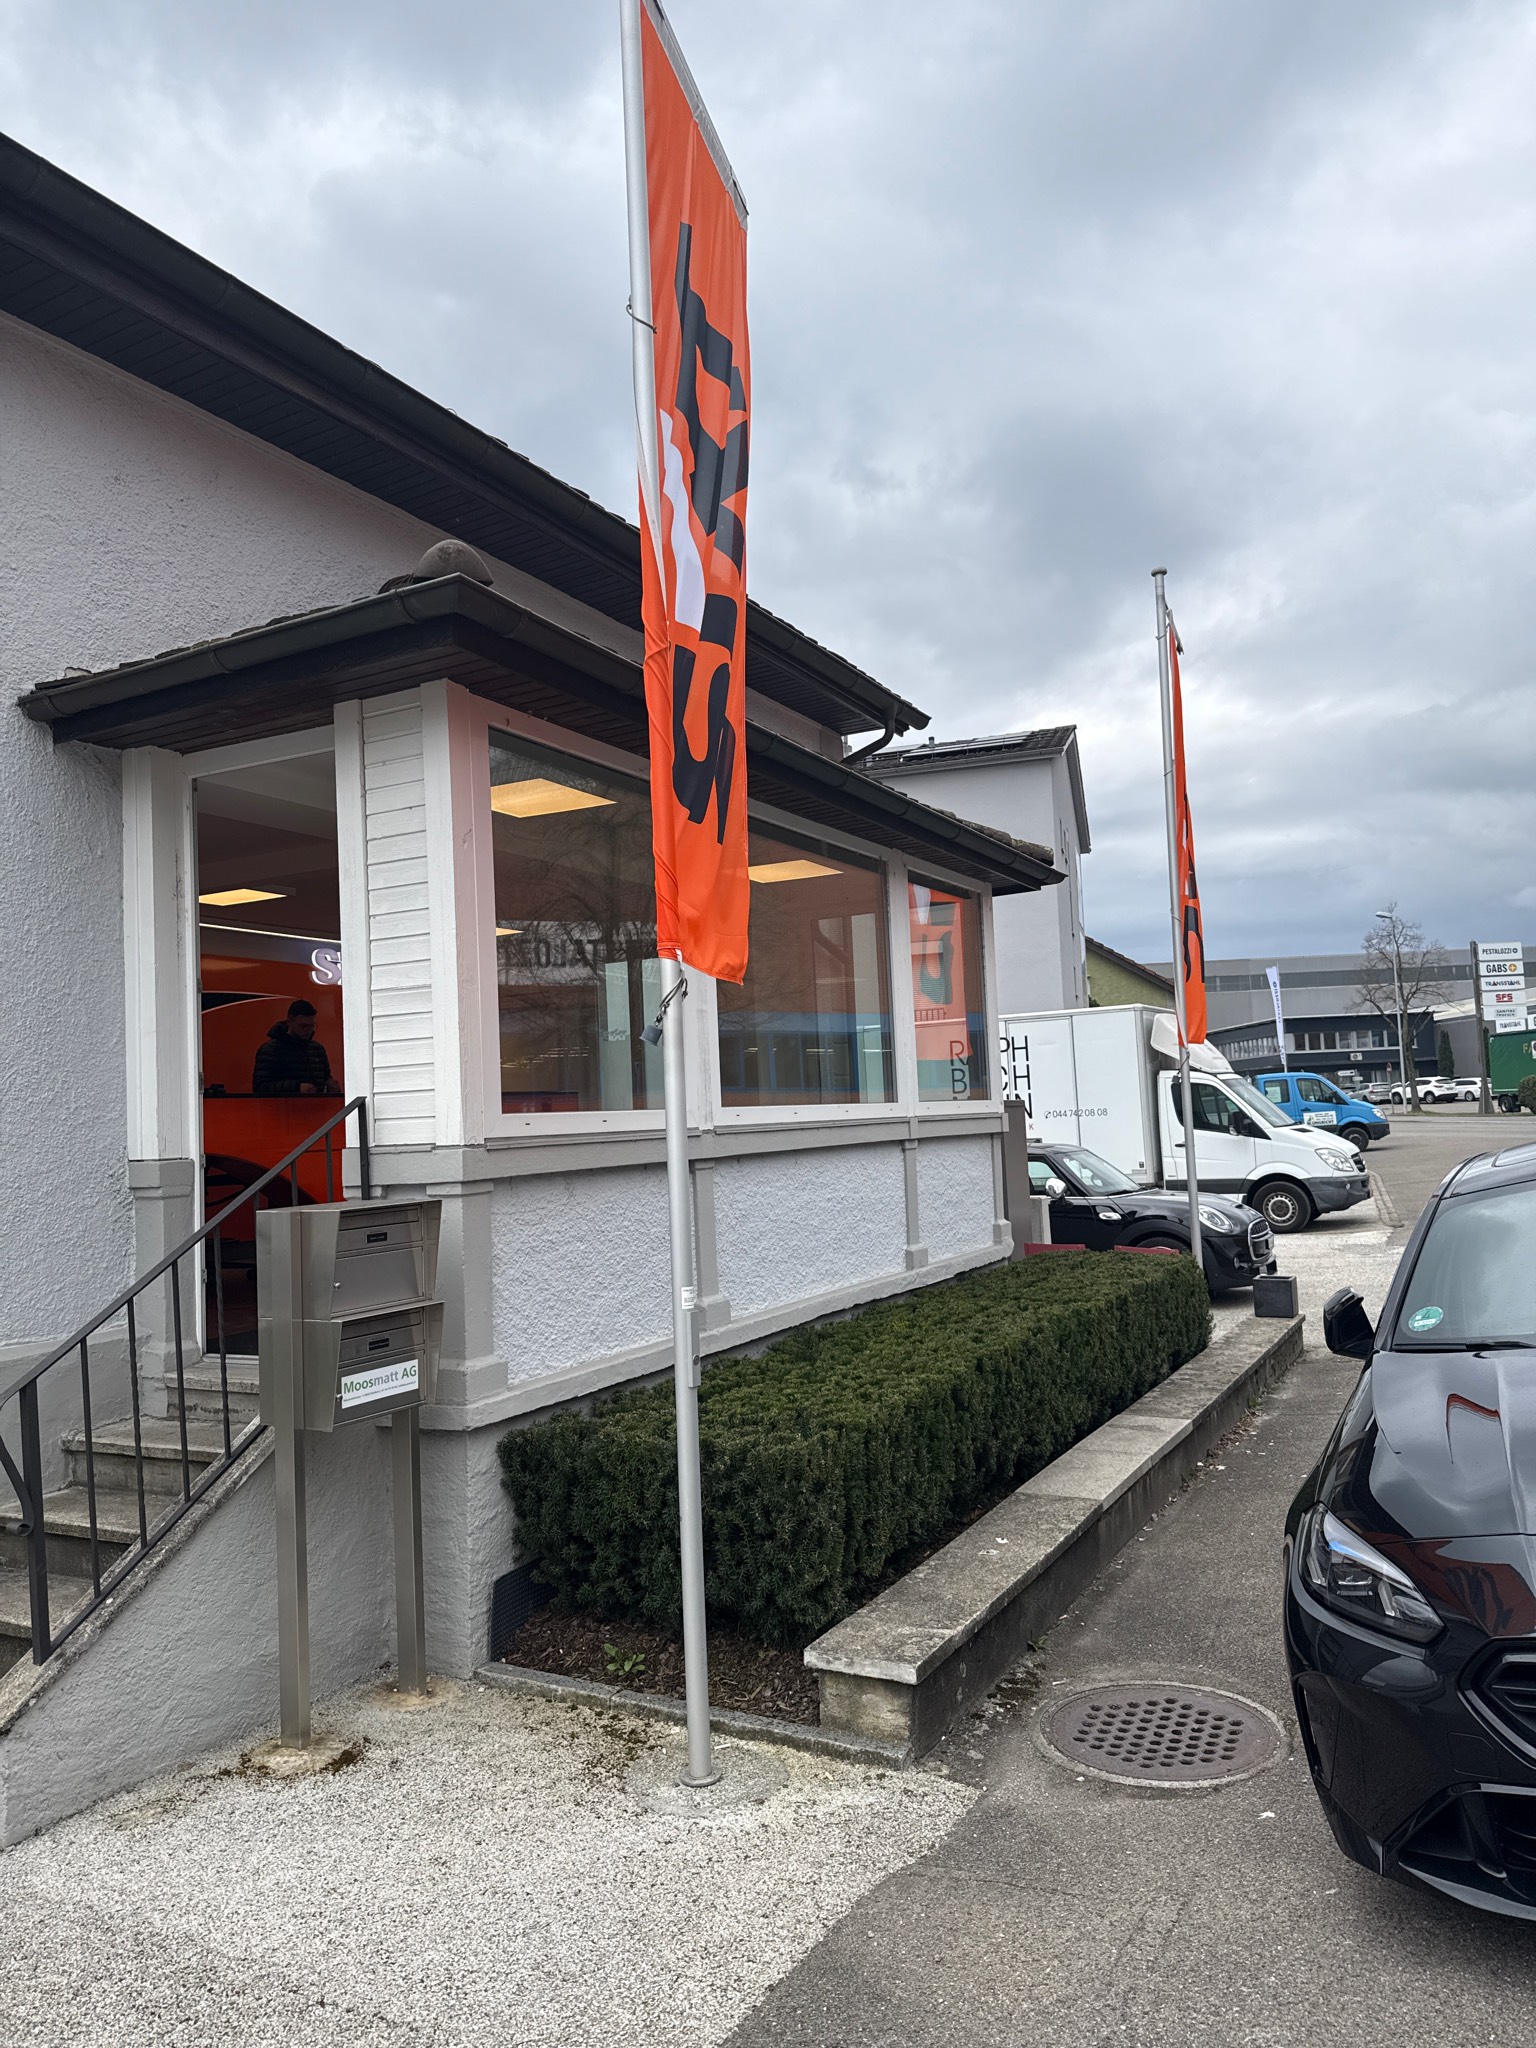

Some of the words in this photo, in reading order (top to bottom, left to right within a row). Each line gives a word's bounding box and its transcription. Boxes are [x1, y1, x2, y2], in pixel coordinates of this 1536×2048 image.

[1482, 947, 1512, 955] PESTALOZZI
[1486, 963, 1508, 974] GABS
[1495, 993, 1513, 1001] SFS
[1052, 1109, 1068, 1118] 044
[1069, 1109, 1084, 1117] 742
[1084, 1108, 1096, 1117] 08
[1097, 1107, 1108, 1116] 08
[343, 1370, 399, 1395] Moosmatt
[401, 1365, 417, 1380] AG
